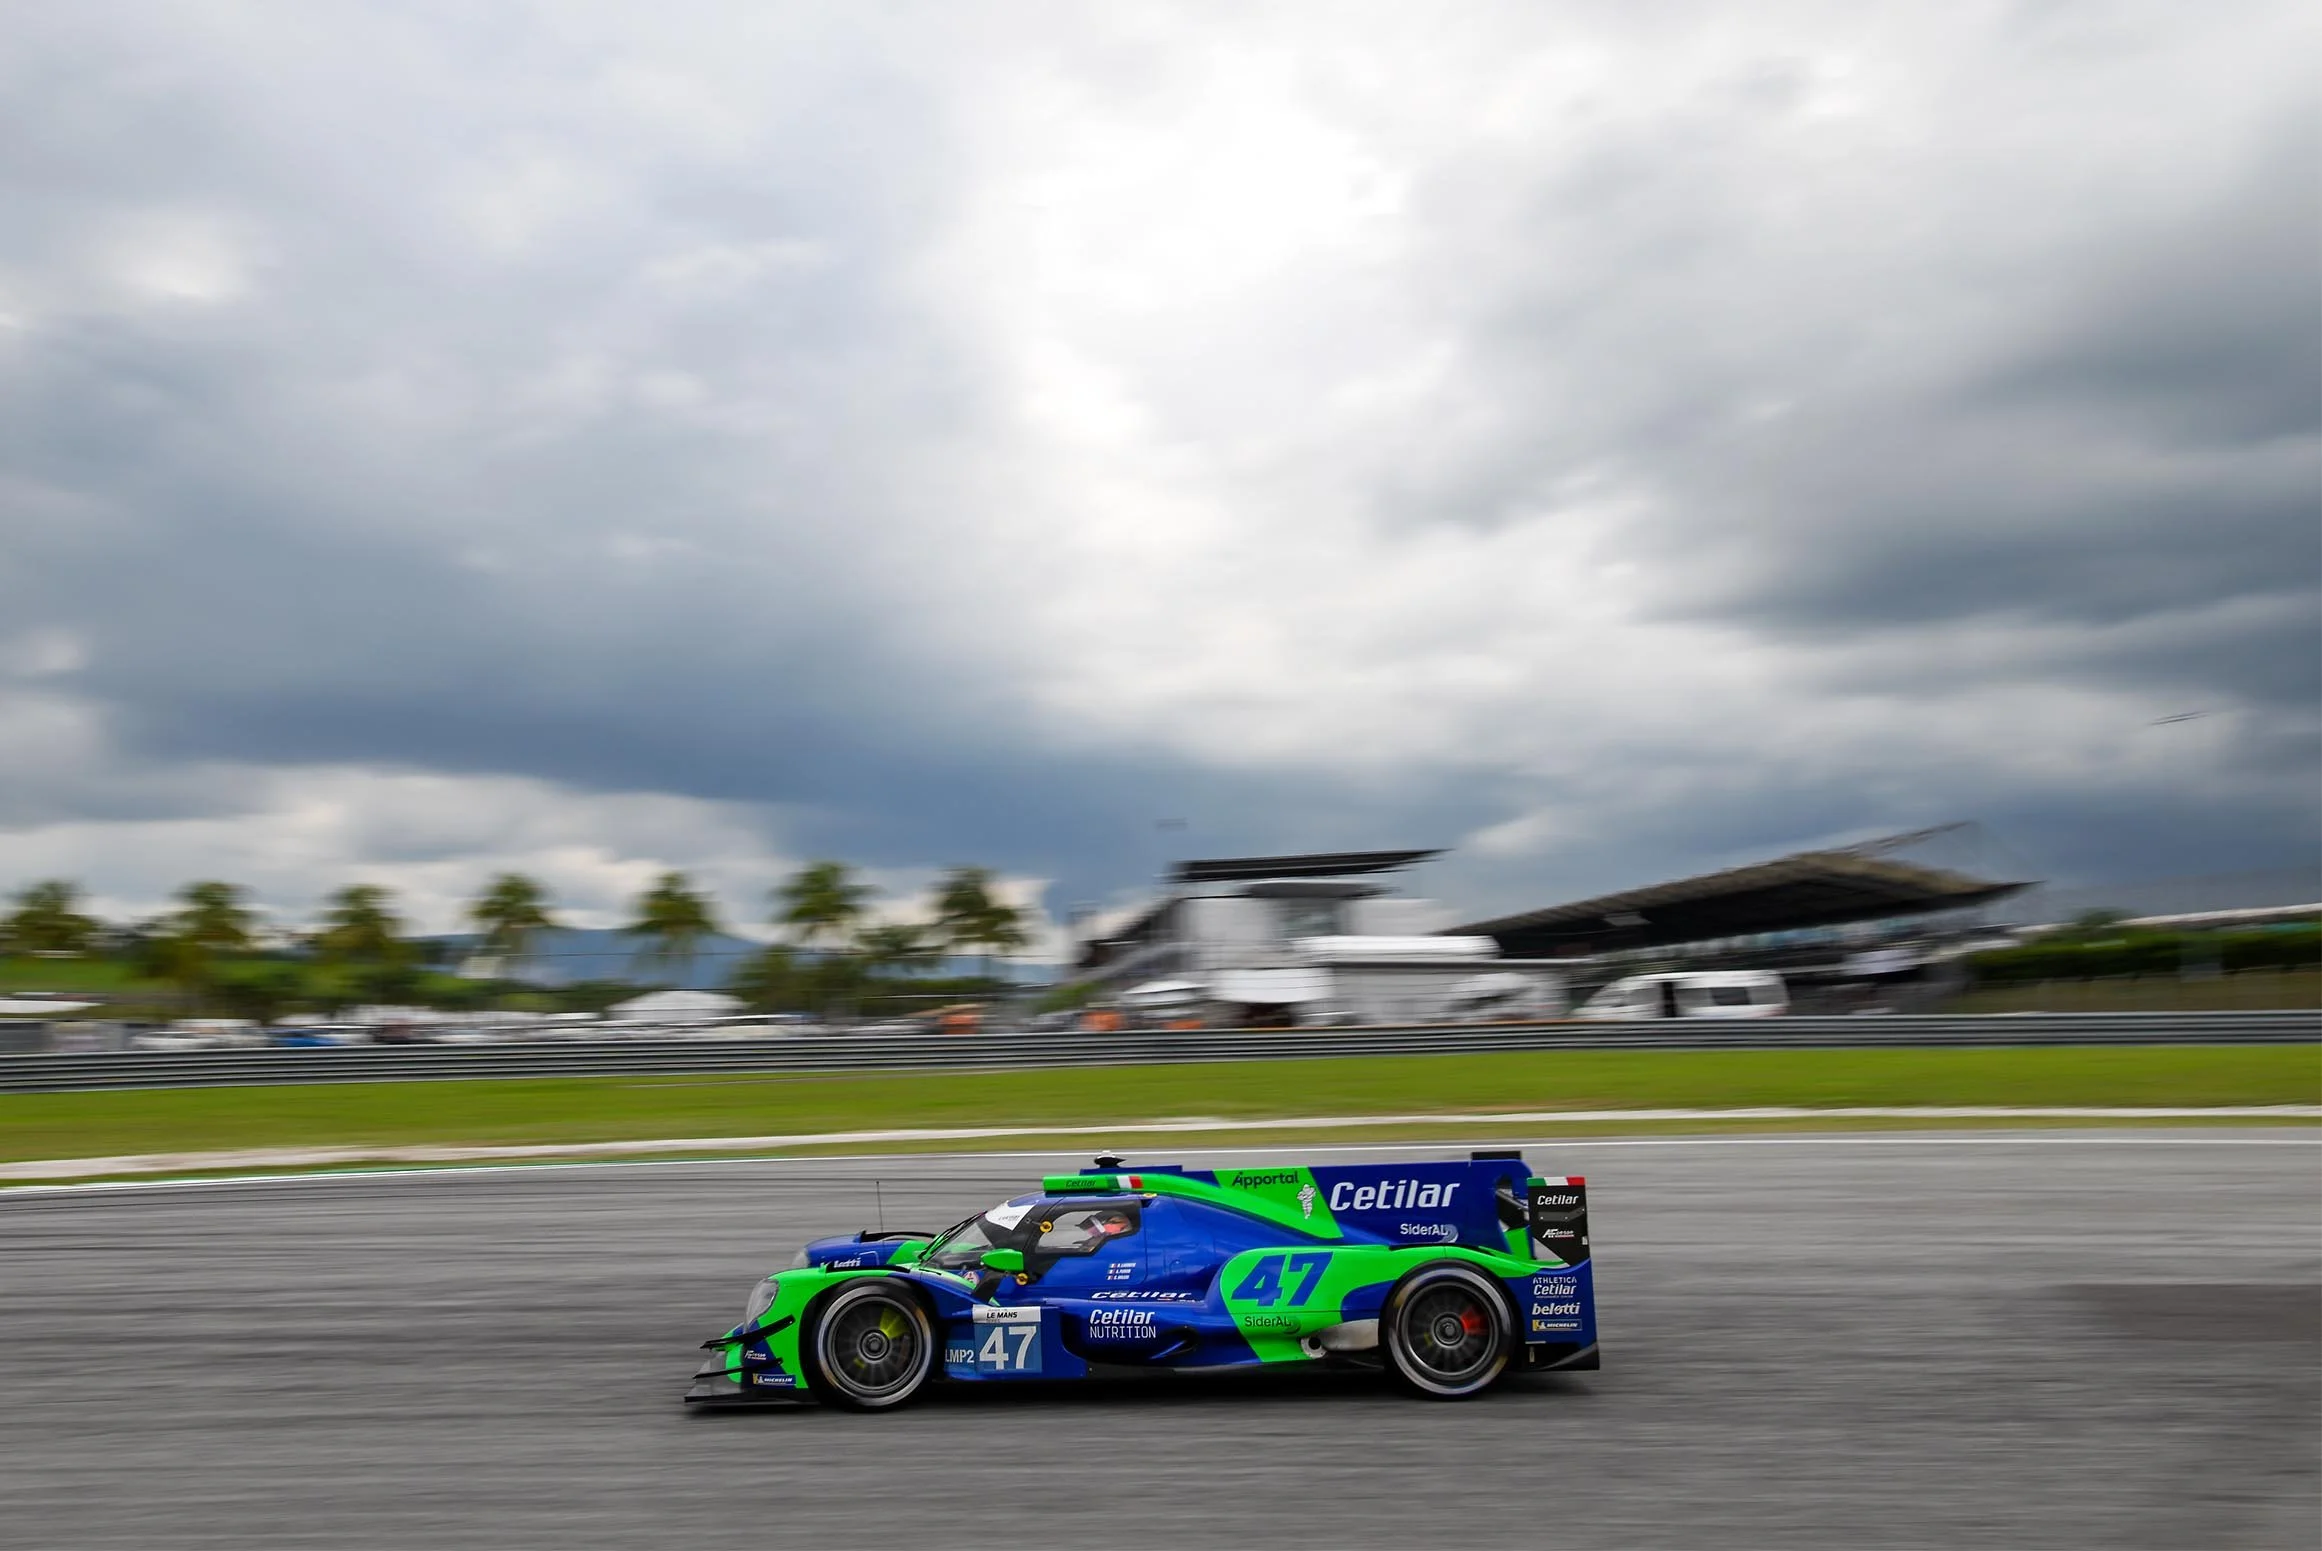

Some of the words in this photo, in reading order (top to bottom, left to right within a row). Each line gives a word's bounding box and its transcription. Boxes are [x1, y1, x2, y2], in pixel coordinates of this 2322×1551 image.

[1329, 1179, 1460, 1212] Cetilar
[1537, 1195, 1579, 1206] Cetilar
[1400, 1223, 1449, 1236] SiderAL
[1231, 1252, 1333, 1307] 47
[1532, 1276, 1577, 1284] ATHLETICA
[1092, 1291, 1192, 1299] Cetilar
[1533, 1284, 1577, 1296] Cetilar
[997, 1311, 1018, 1319] MANS
[1531, 1303, 1581, 1315] belotti
[1089, 1309, 1155, 1325] Cetilar
[1244, 1316, 1292, 1328] SiderAL
[1090, 1325, 1157, 1339] NUTRITION
[979, 1326, 1037, 1371] 47
[944, 1349, 975, 1364] LMP2
